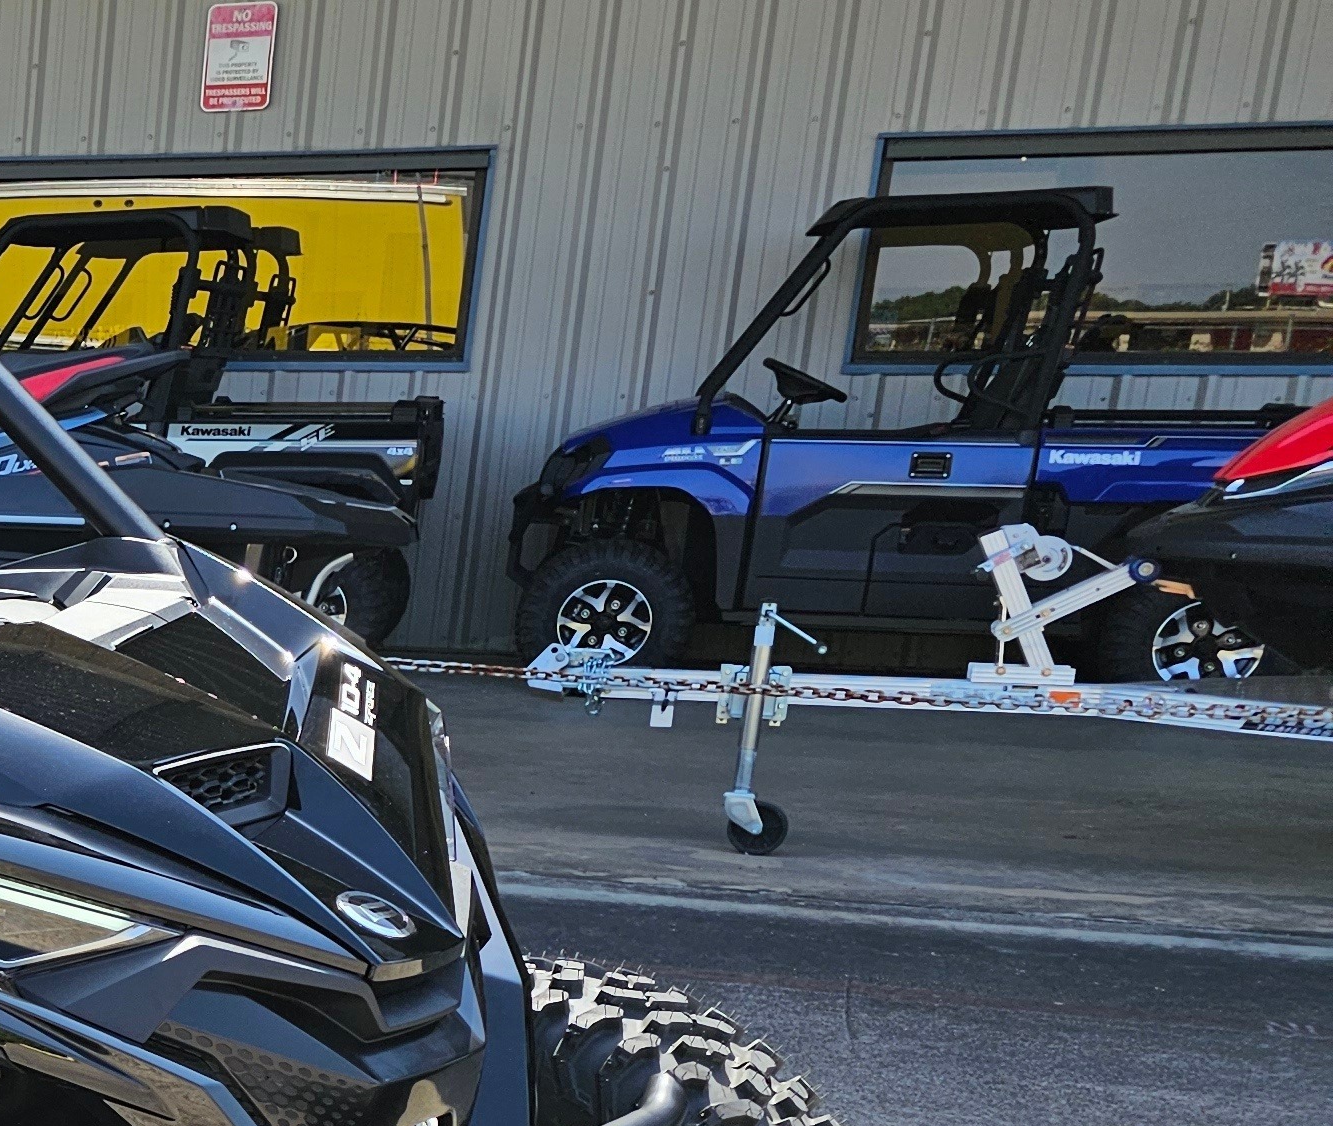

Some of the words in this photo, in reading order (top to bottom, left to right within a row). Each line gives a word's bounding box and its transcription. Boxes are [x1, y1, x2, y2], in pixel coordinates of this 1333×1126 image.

[232, 9, 252, 22] NO
[212, 21, 273, 34] TRESPASSING
[205, 88, 250, 97] TRESPASSERS
[251, 87, 266, 95] WILL
[180, 425, 251, 437] Kawasaki
[386, 447, 414, 456] 4x4
[1048, 449, 1142, 466] Kawasaki
